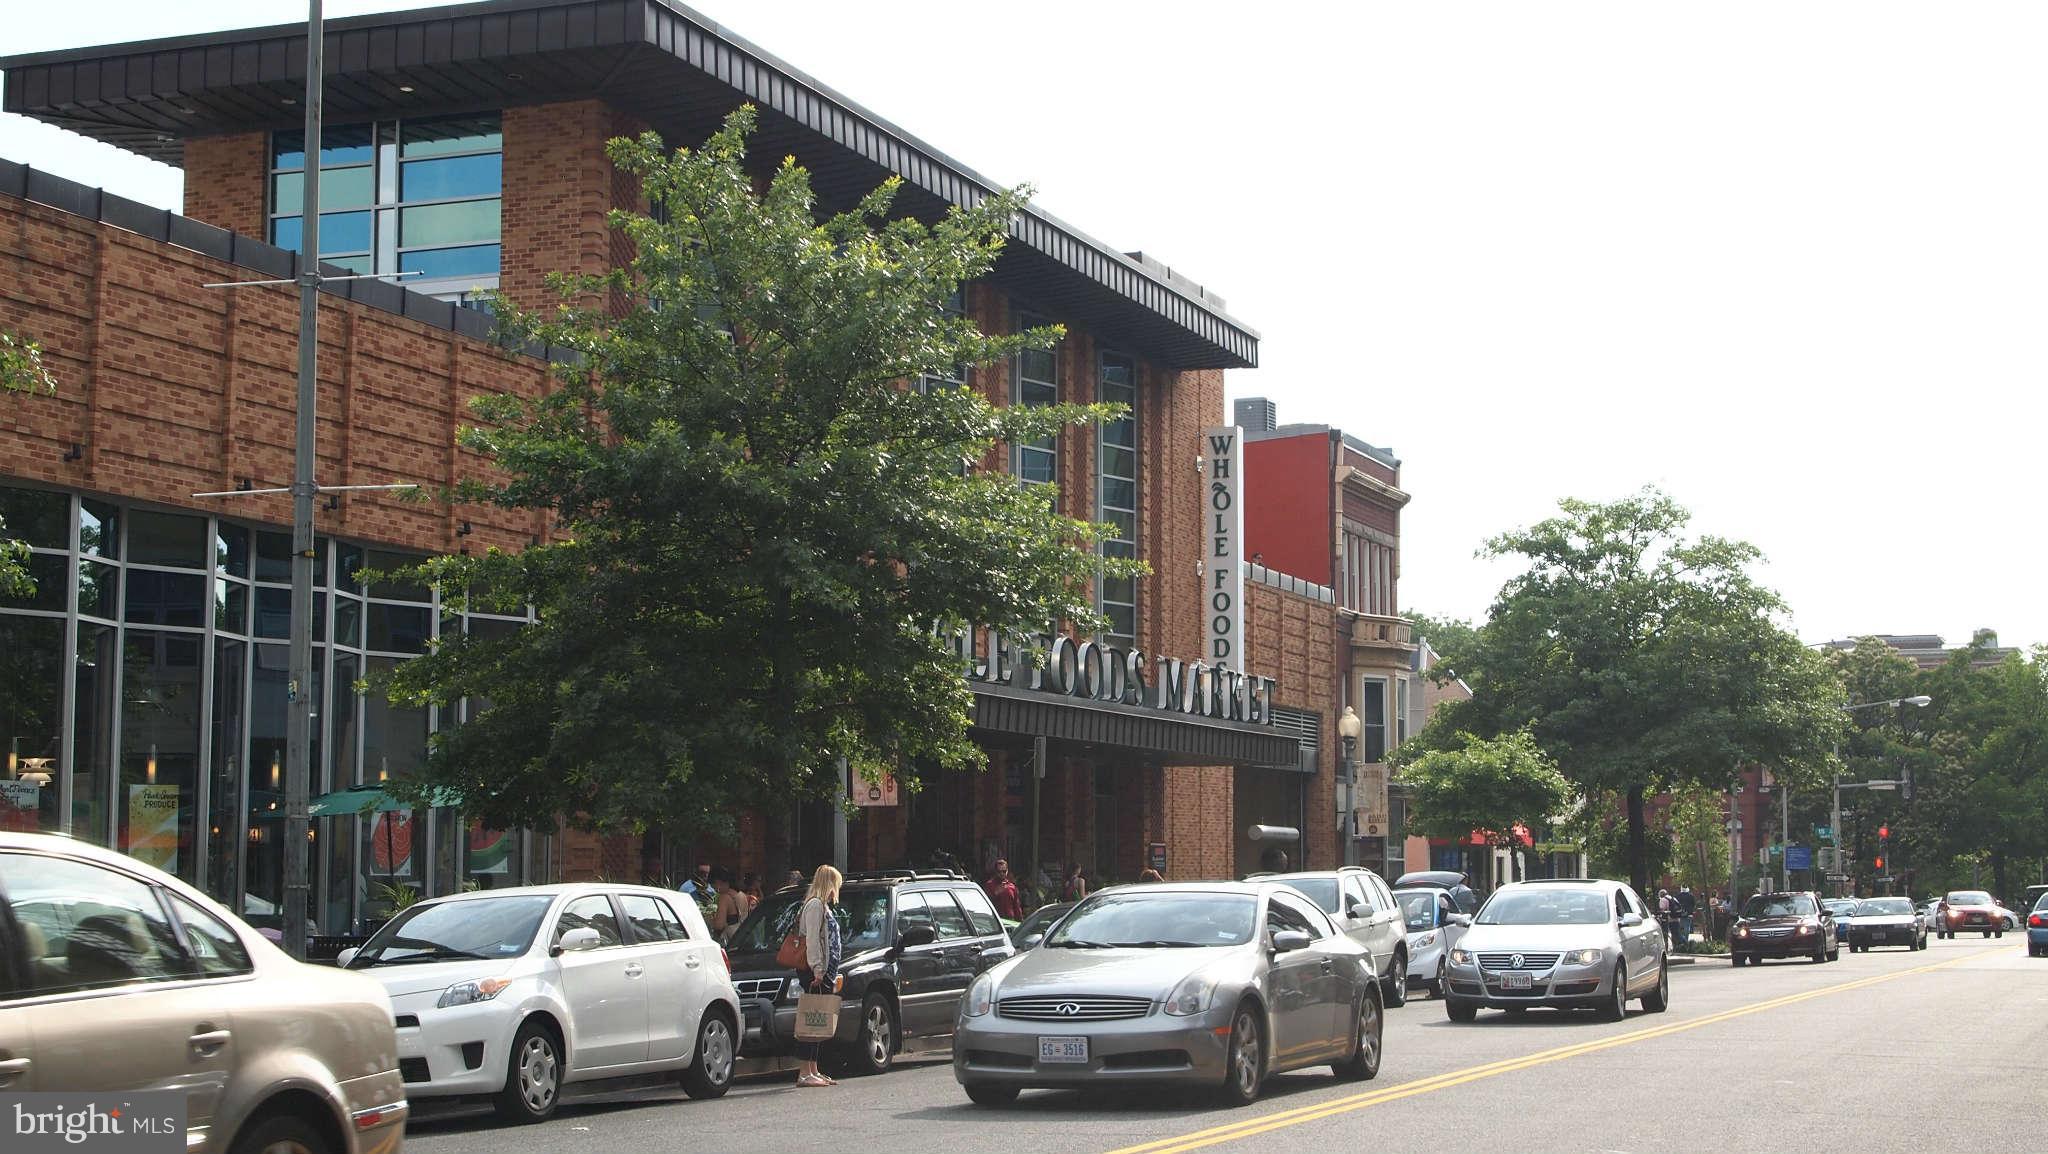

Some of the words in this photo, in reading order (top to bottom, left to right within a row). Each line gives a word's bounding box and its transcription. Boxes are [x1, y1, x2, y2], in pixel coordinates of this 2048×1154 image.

[1209, 435, 1233, 557] WHOLE
[1030, 632, 1145, 706] FOODS
[1157, 655, 1276, 724] MARKET
[143, 800, 177, 808] PRODUCE
